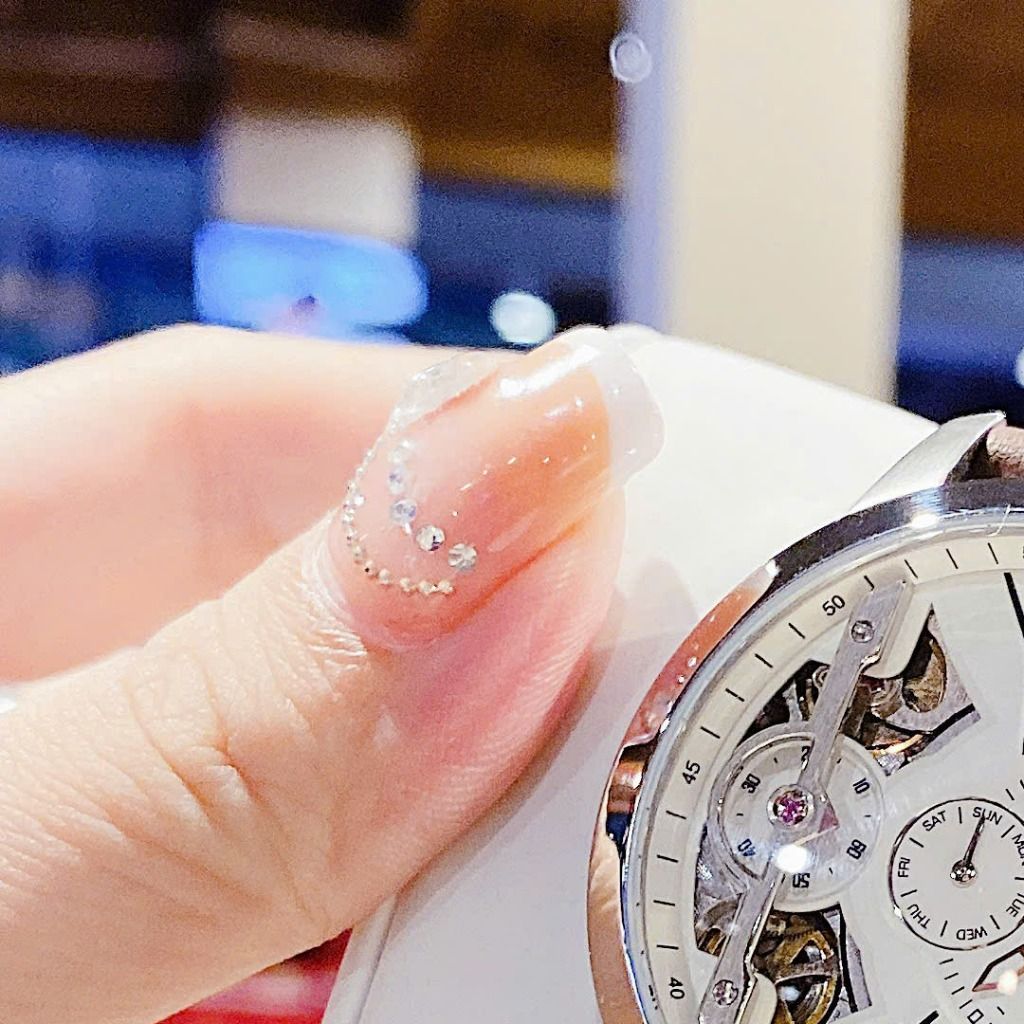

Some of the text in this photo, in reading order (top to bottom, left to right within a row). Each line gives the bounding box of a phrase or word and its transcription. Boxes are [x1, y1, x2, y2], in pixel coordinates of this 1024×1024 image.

[821, 595, 847, 616] 50
[681, 762, 702, 785] 45
[741, 774, 761, 794] 30
[853, 777, 871, 795] 10
[922, 810, 947, 832] SAT
[972, 806, 1003, 826] SUN
[897, 857, 911, 878] FRI
[792, 873, 811, 889] 50
[906, 903, 931, 929] THU
[955, 925, 988, 941] WED
[668, 976, 686, 999] 40
